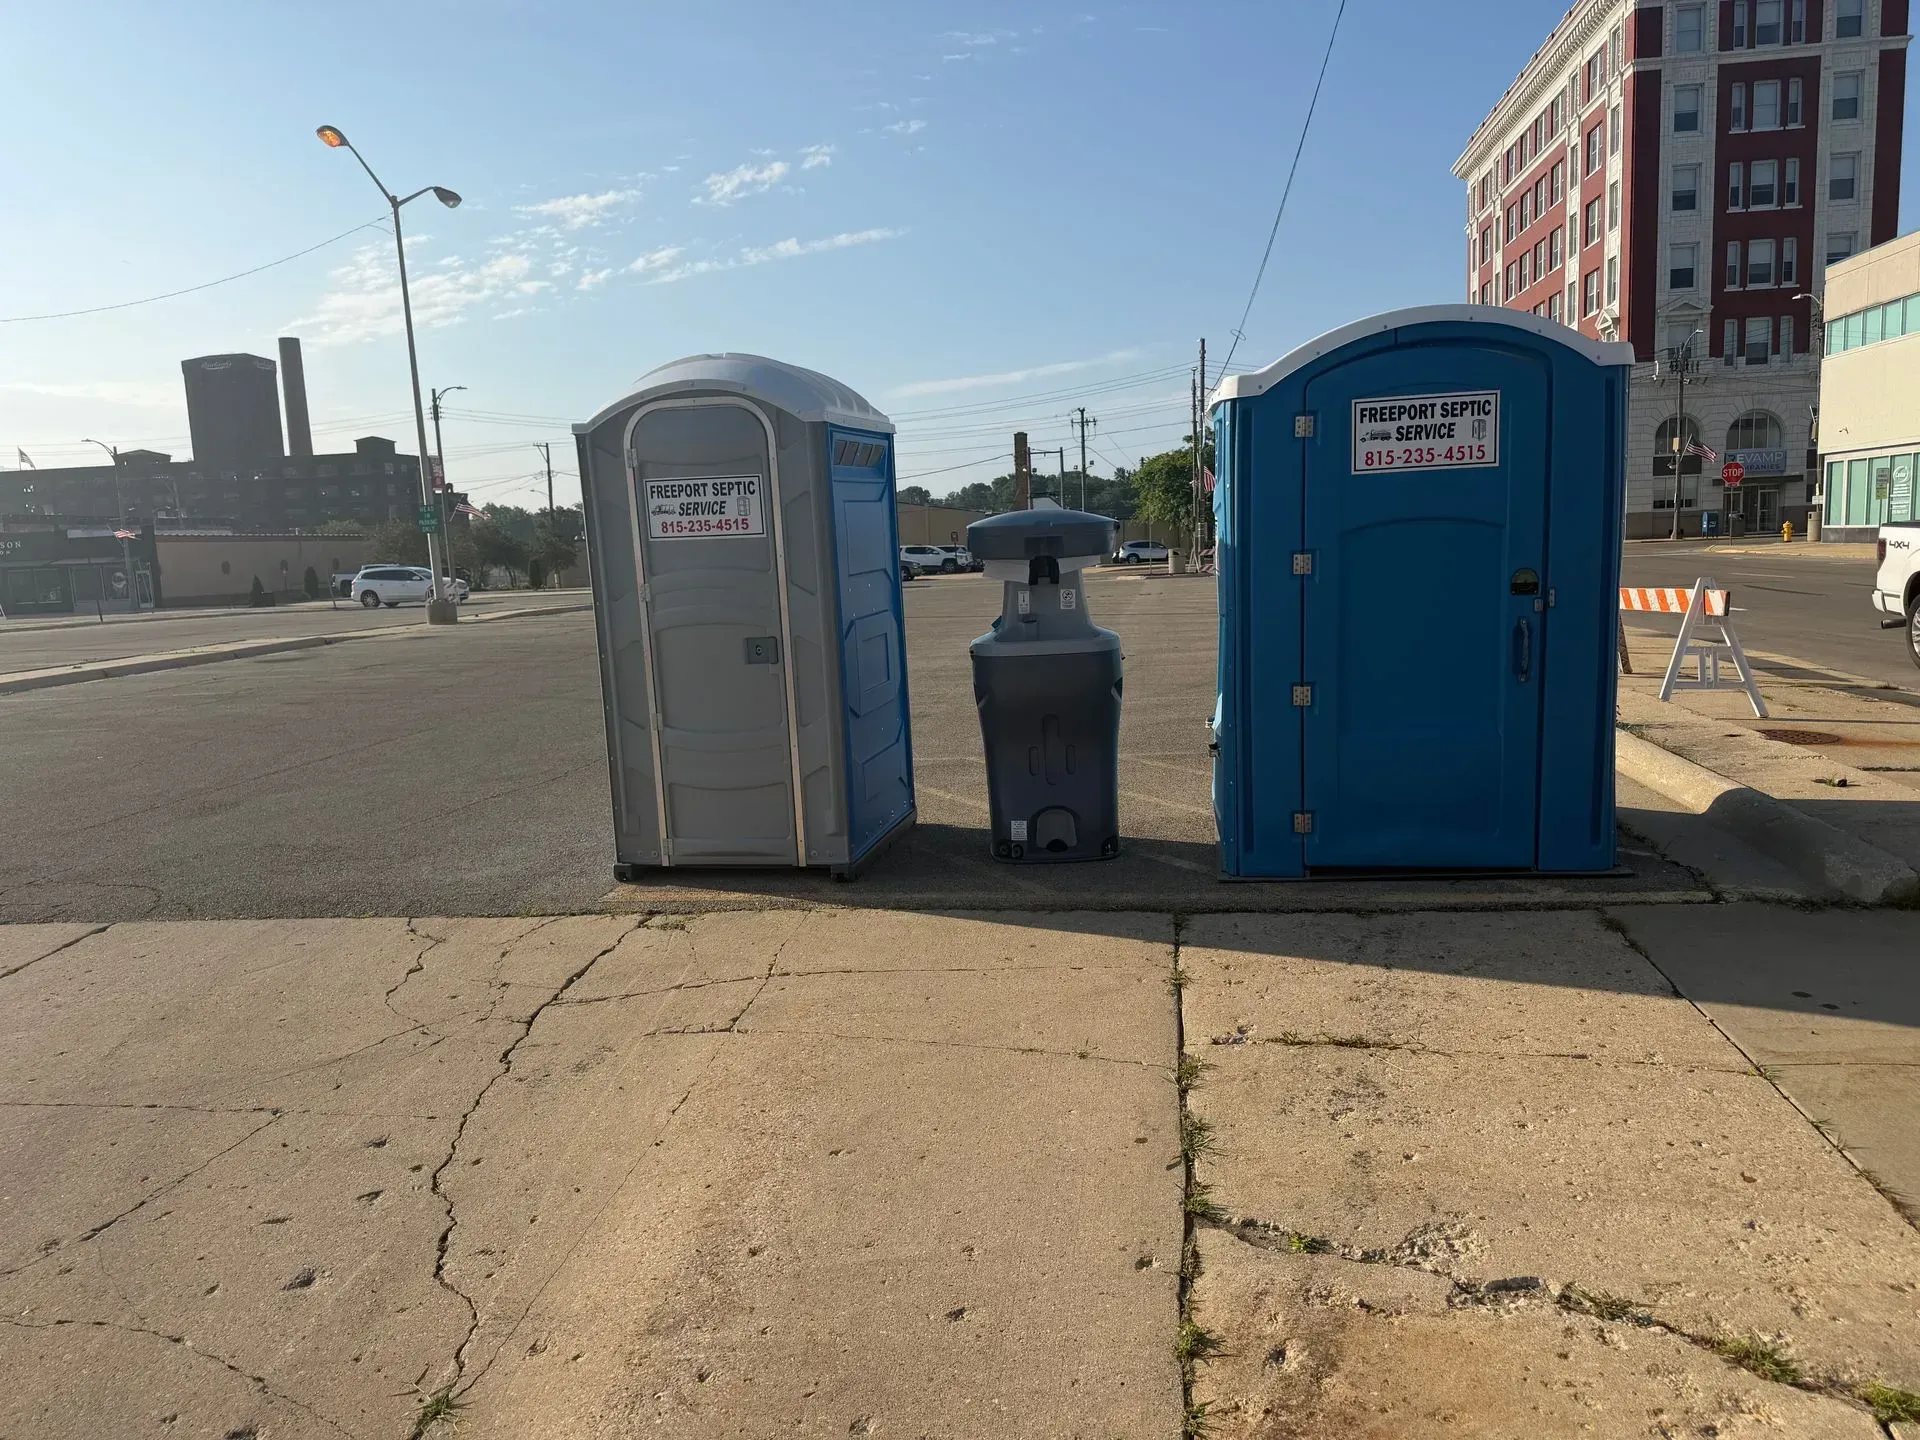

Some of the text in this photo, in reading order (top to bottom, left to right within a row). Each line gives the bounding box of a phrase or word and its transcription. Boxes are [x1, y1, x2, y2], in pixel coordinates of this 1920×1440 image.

[1360, 400, 1491, 423] FREEPORT SEPTIC
[1395, 423, 1456, 441] SERVICE
[1365, 445, 1485, 466] 815-235-4515
[1722, 468, 1744, 478] STOP
[650, 481, 755, 499] FREEPORT SEPTIC
[678, 501, 726, 516] SERVICE
[661, 518, 749, 533] 815-235-4515
